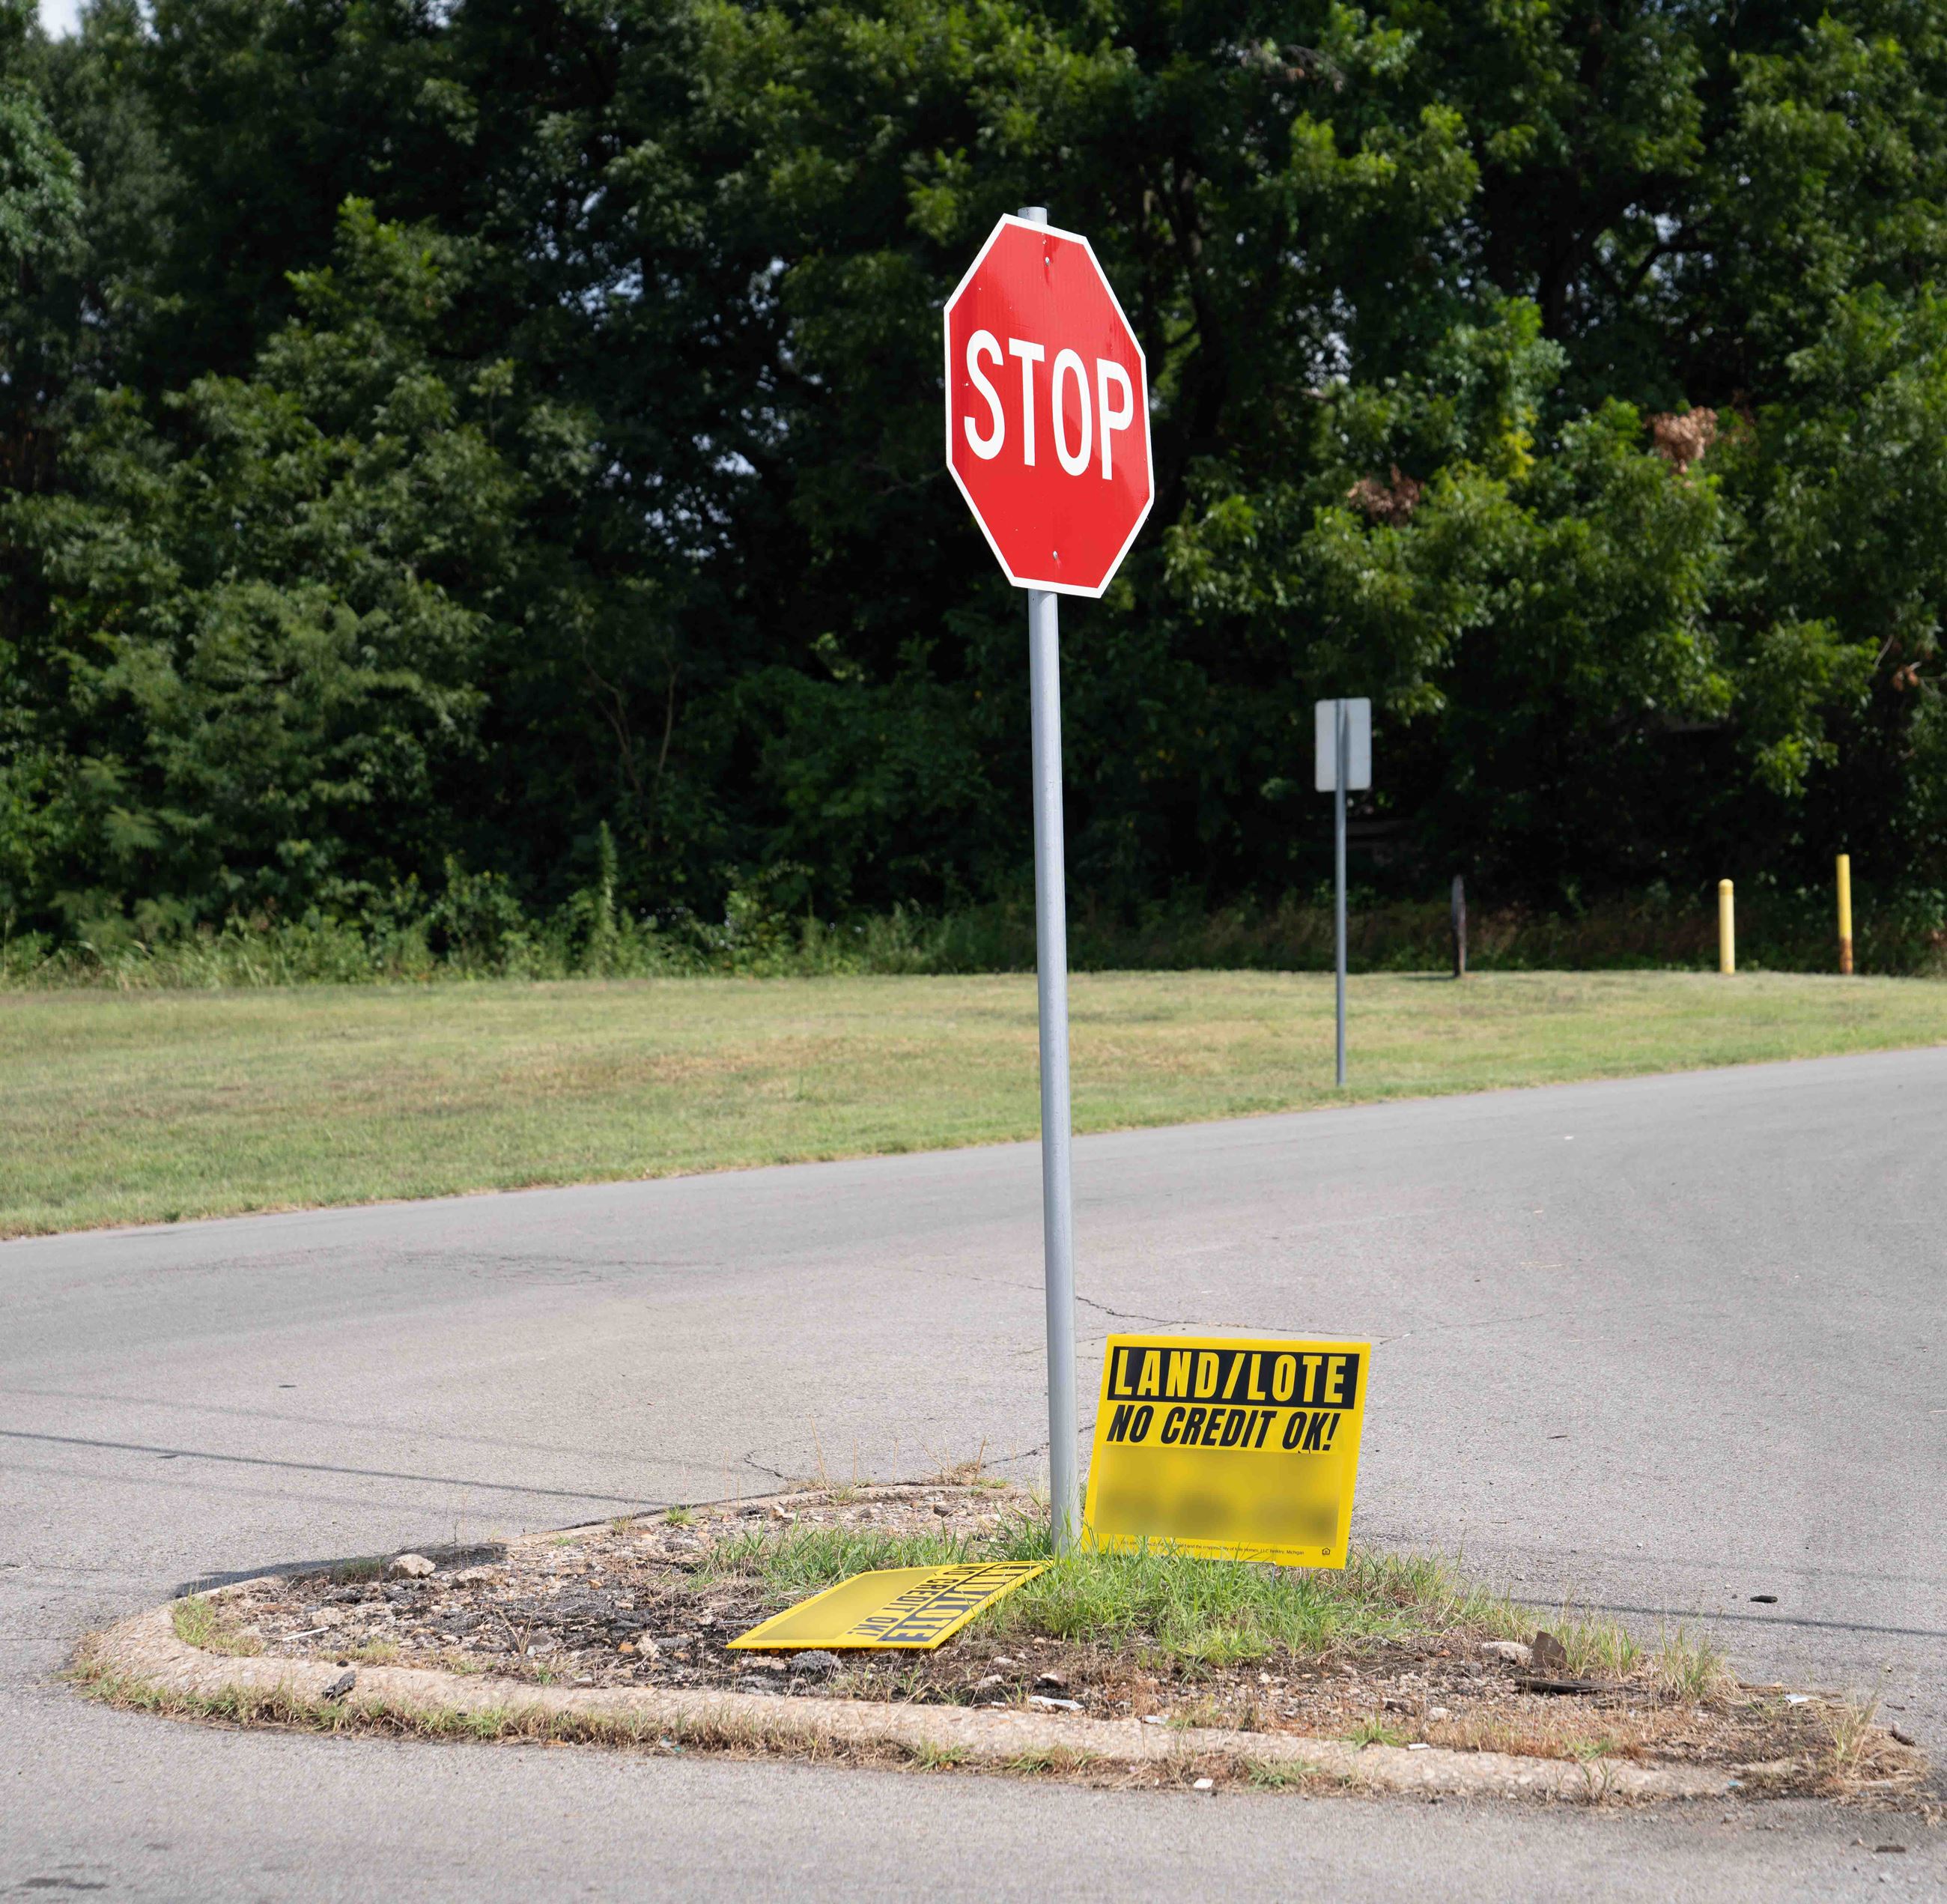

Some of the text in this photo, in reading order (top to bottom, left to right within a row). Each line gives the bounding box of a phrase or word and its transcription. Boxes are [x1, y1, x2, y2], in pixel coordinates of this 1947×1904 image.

[964, 330, 1134, 480] STOP
[1114, 1350, 1348, 1403] LAND/LOTE
[1106, 1404, 1341, 1451] NO CREDIT OK!
[847, 1565, 987, 1636] NO CREDIT OK!
